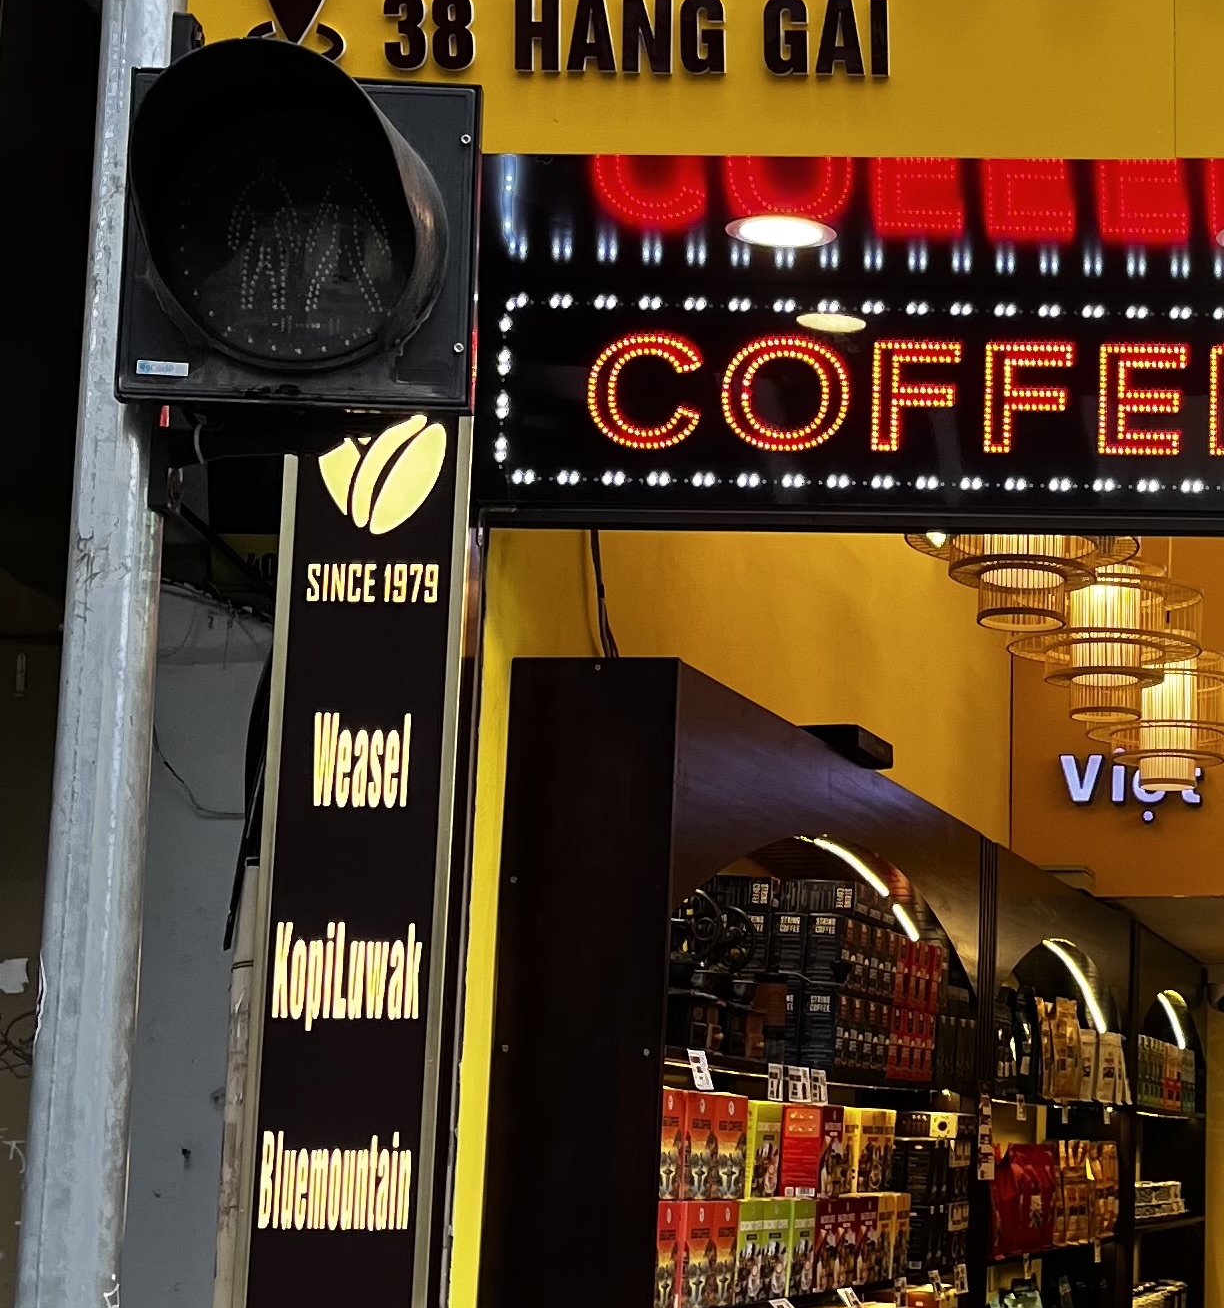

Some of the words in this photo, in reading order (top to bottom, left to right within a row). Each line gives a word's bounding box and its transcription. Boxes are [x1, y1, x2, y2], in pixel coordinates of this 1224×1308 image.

[306, 563, 376, 603] SINCE
[384, 562, 439, 603] 1979
[312, 712, 412, 808] Weasel
[257, 1130, 412, 1231] Bluemountain
